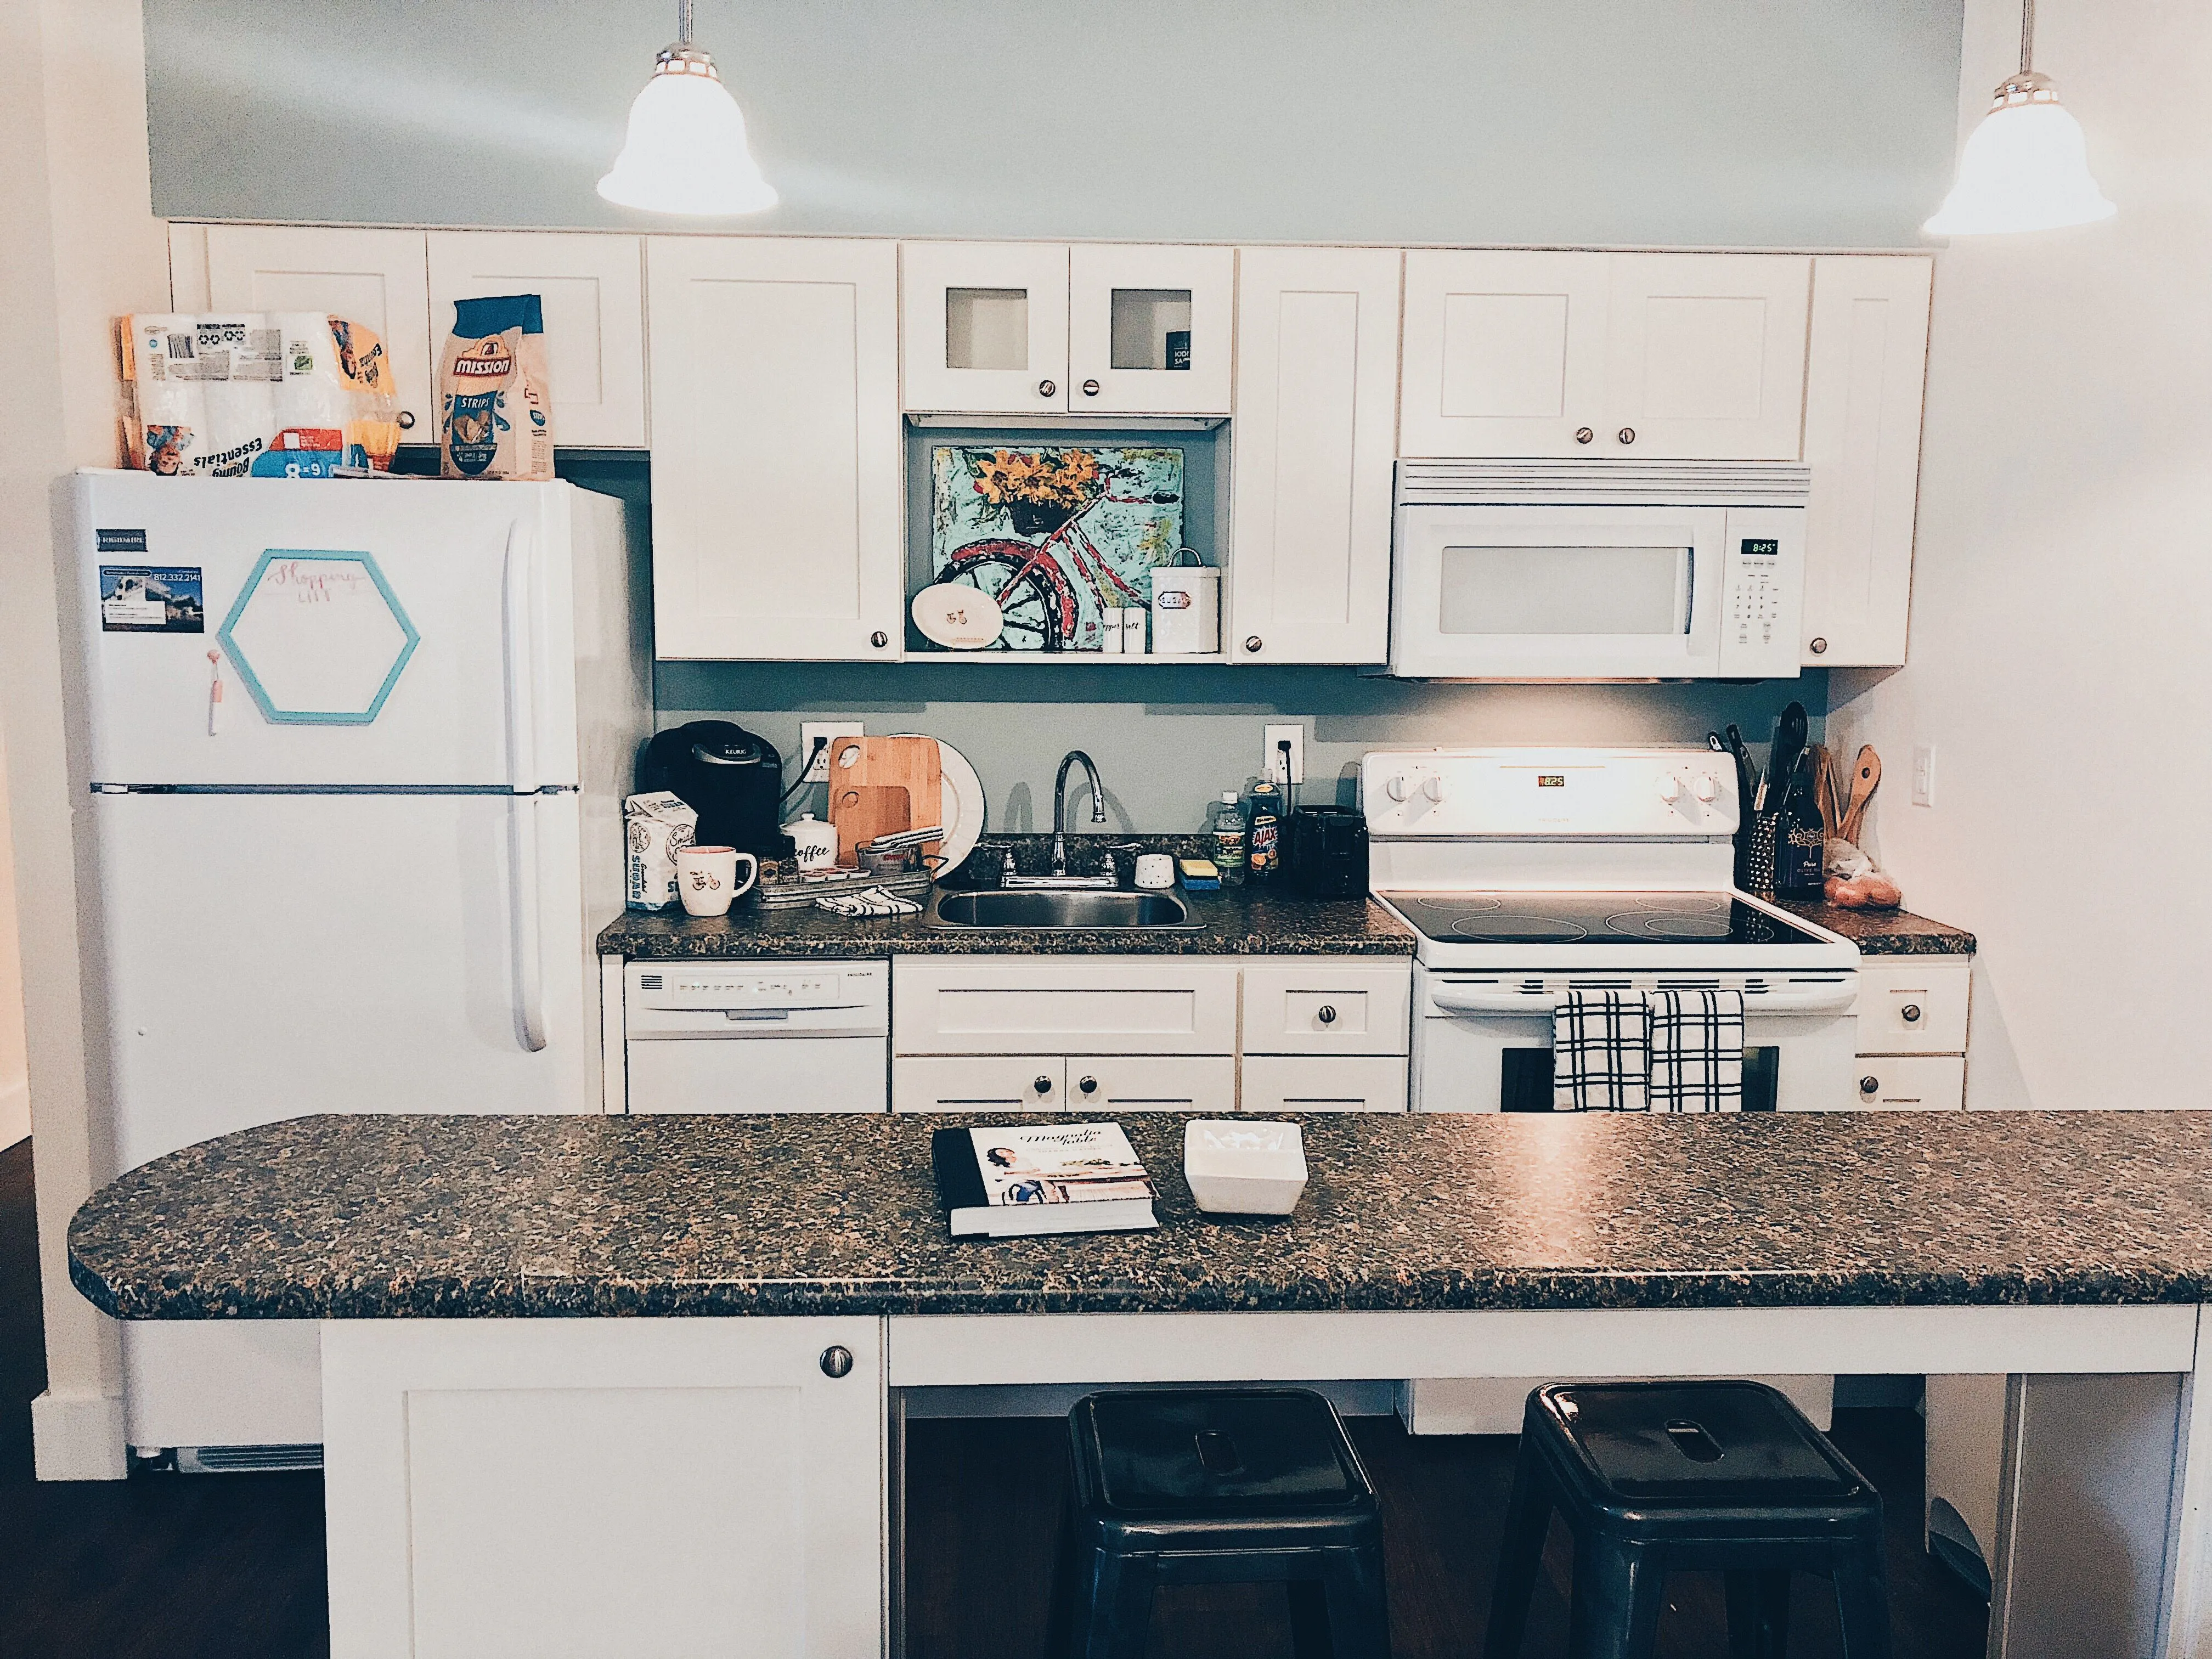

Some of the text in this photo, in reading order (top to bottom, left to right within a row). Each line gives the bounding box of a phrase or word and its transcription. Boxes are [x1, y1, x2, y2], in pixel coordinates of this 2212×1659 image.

[456, 359, 510, 375] MISSION
[461, 397, 490, 408] STRIPS
[194, 437, 262, 469] Essentials
[1753, 544, 1772, 552] 8:25
[267, 561, 366, 590] Shopping
[1255, 828, 1276, 845] AJAX
[632, 855, 641, 899] SUGAR
